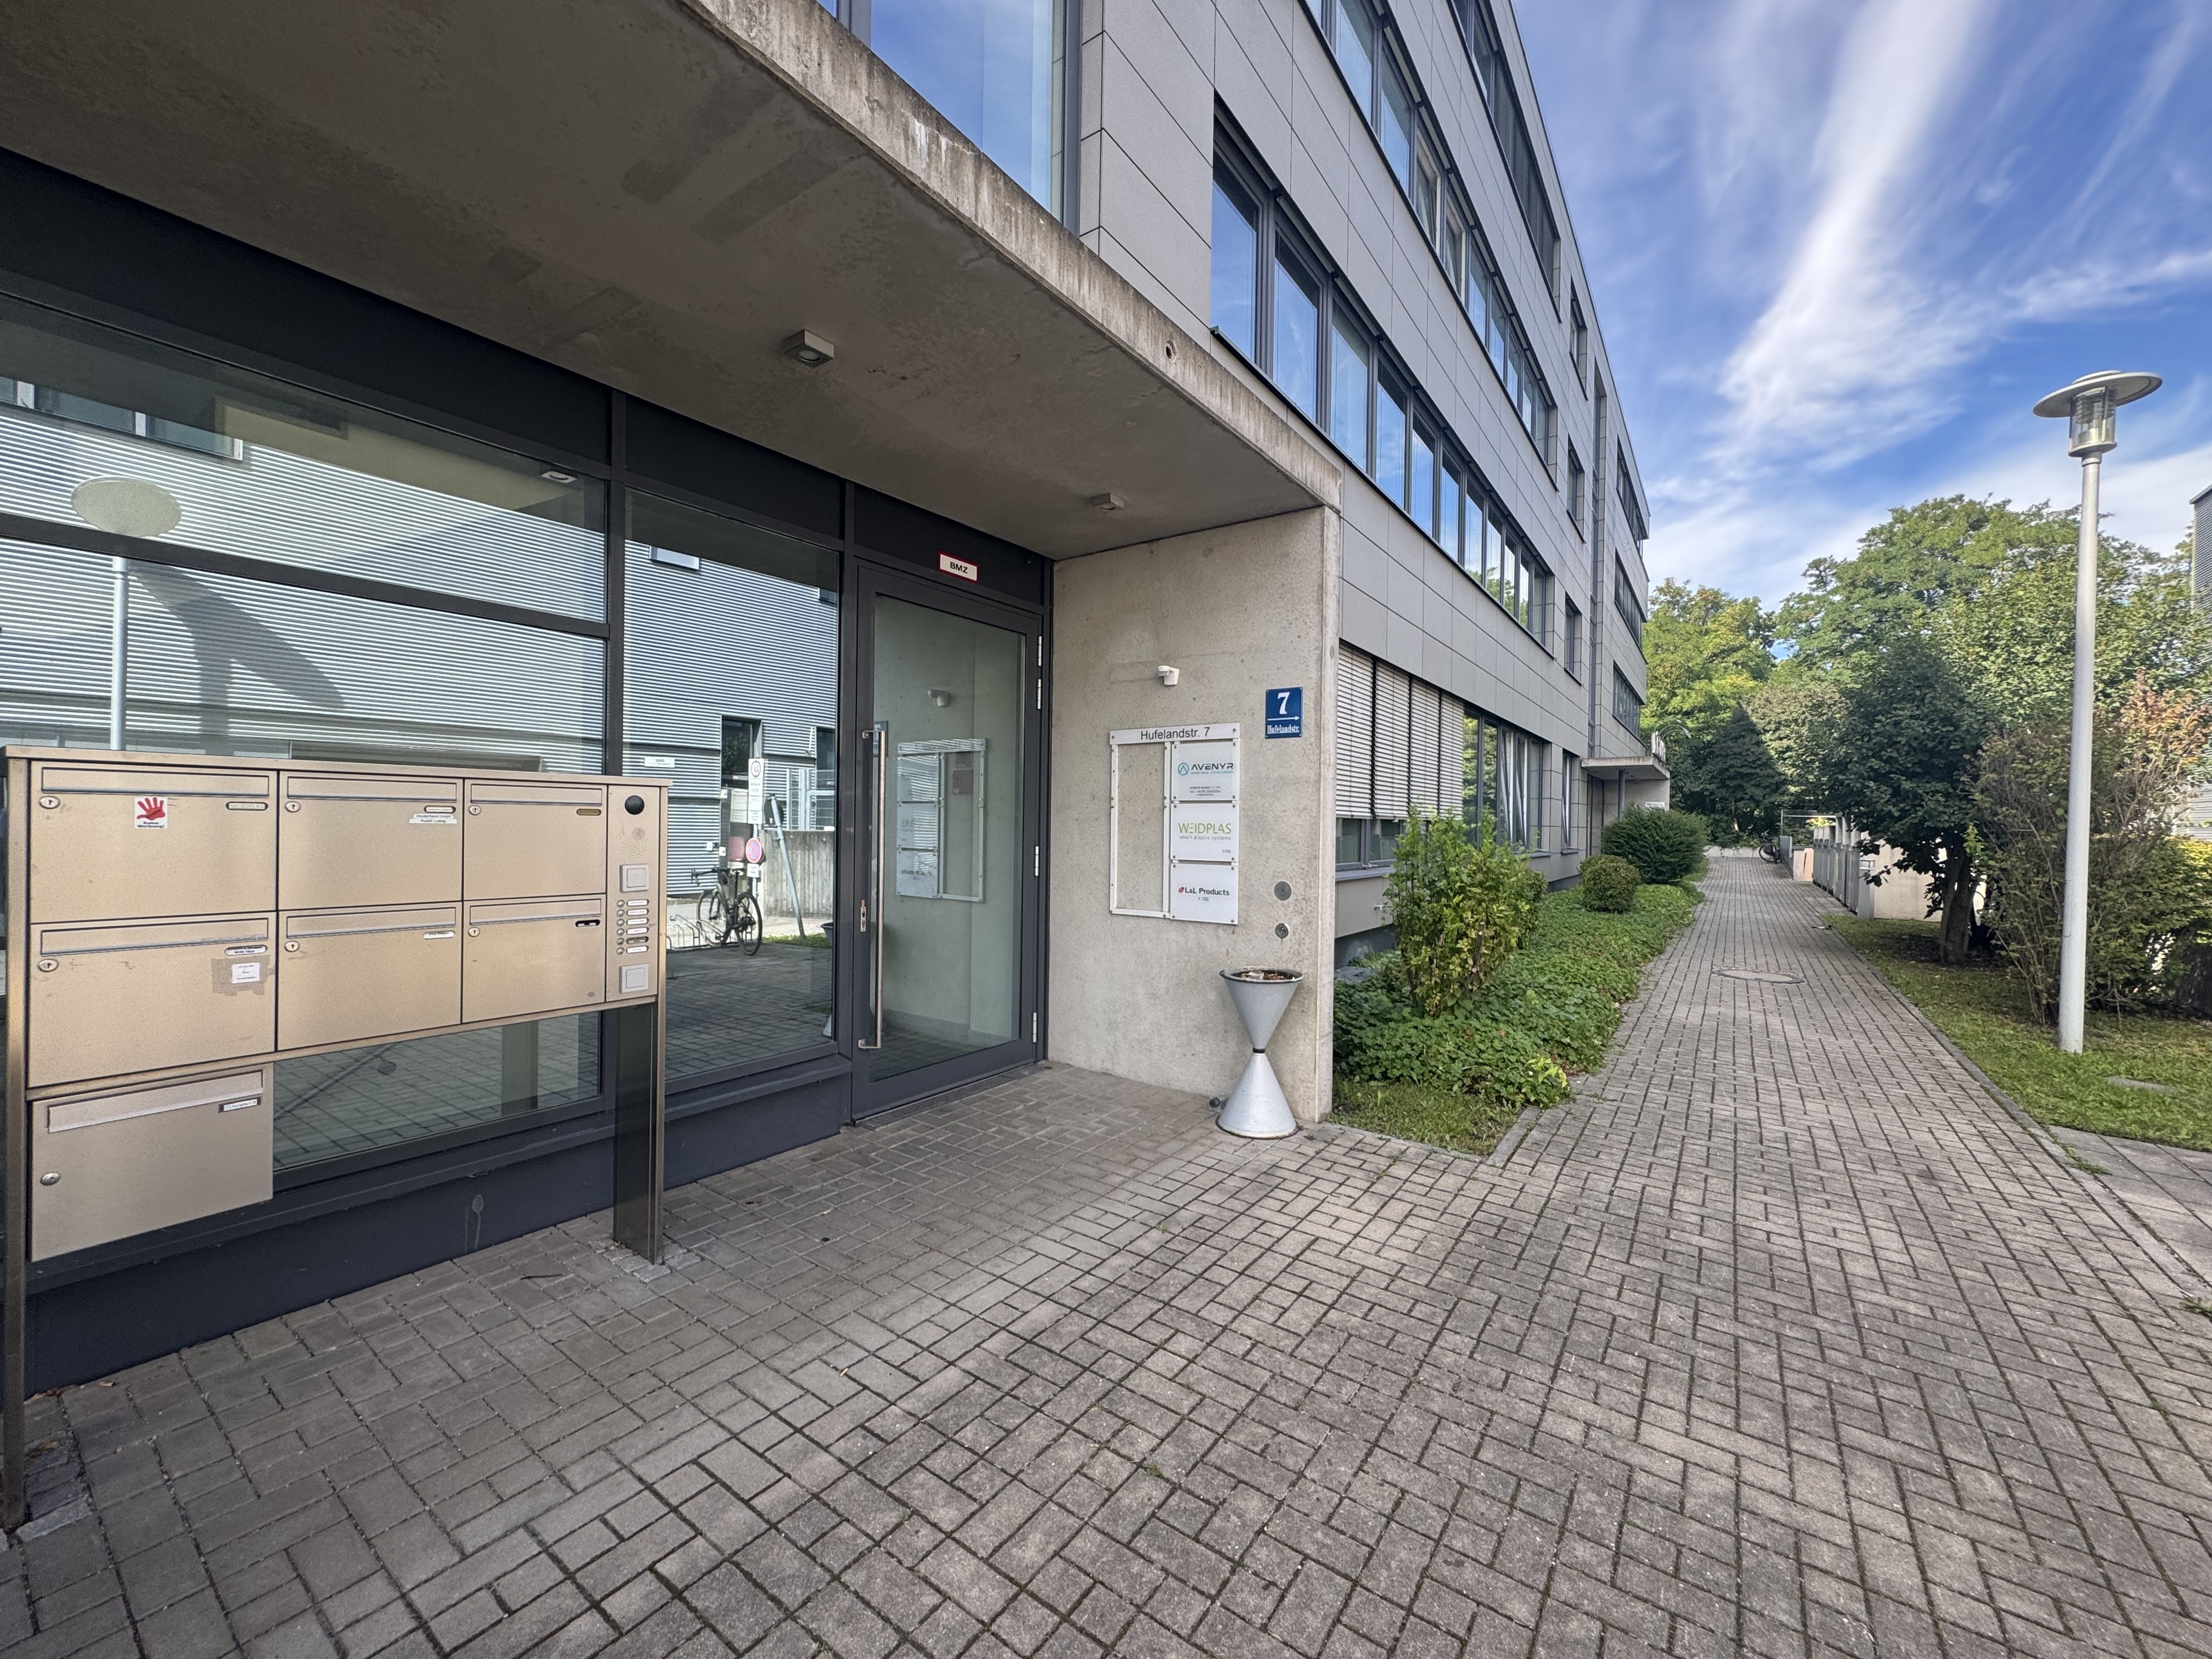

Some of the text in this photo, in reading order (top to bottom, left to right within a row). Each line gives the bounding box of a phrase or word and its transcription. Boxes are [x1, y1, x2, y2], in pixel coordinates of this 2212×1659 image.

[950, 561, 968, 574] BMZ
[1277, 692, 1290, 715] 7
[1141, 727, 1210, 740] Hufelandstr. 7
[1267, 724, 1300, 734] Hufelandstr.
[1178, 822, 1232, 834] WEIDPLAS
[1199, 888, 1229, 896] Products
